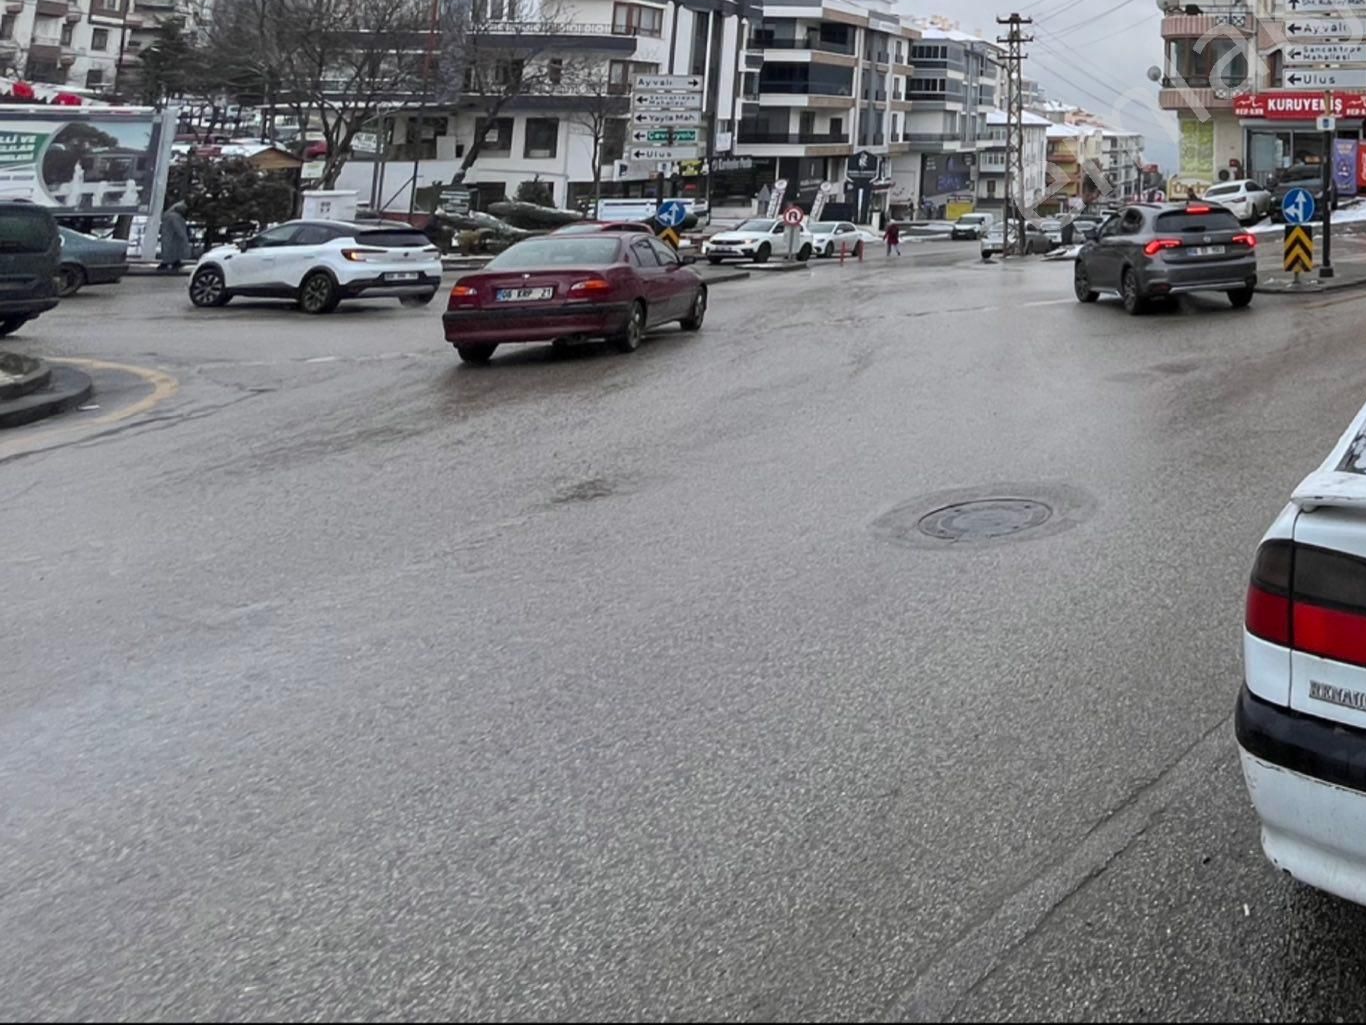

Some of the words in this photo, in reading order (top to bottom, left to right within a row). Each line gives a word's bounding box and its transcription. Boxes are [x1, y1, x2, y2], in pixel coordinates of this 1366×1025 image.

[1303, 21, 1348, 34] Ayvalı
[638, 76, 673, 87] Ayvalı
[1303, 74, 1336, 85] Ulus
[648, 114, 674, 123] Yayla
[646, 150, 672, 158] Ulus
